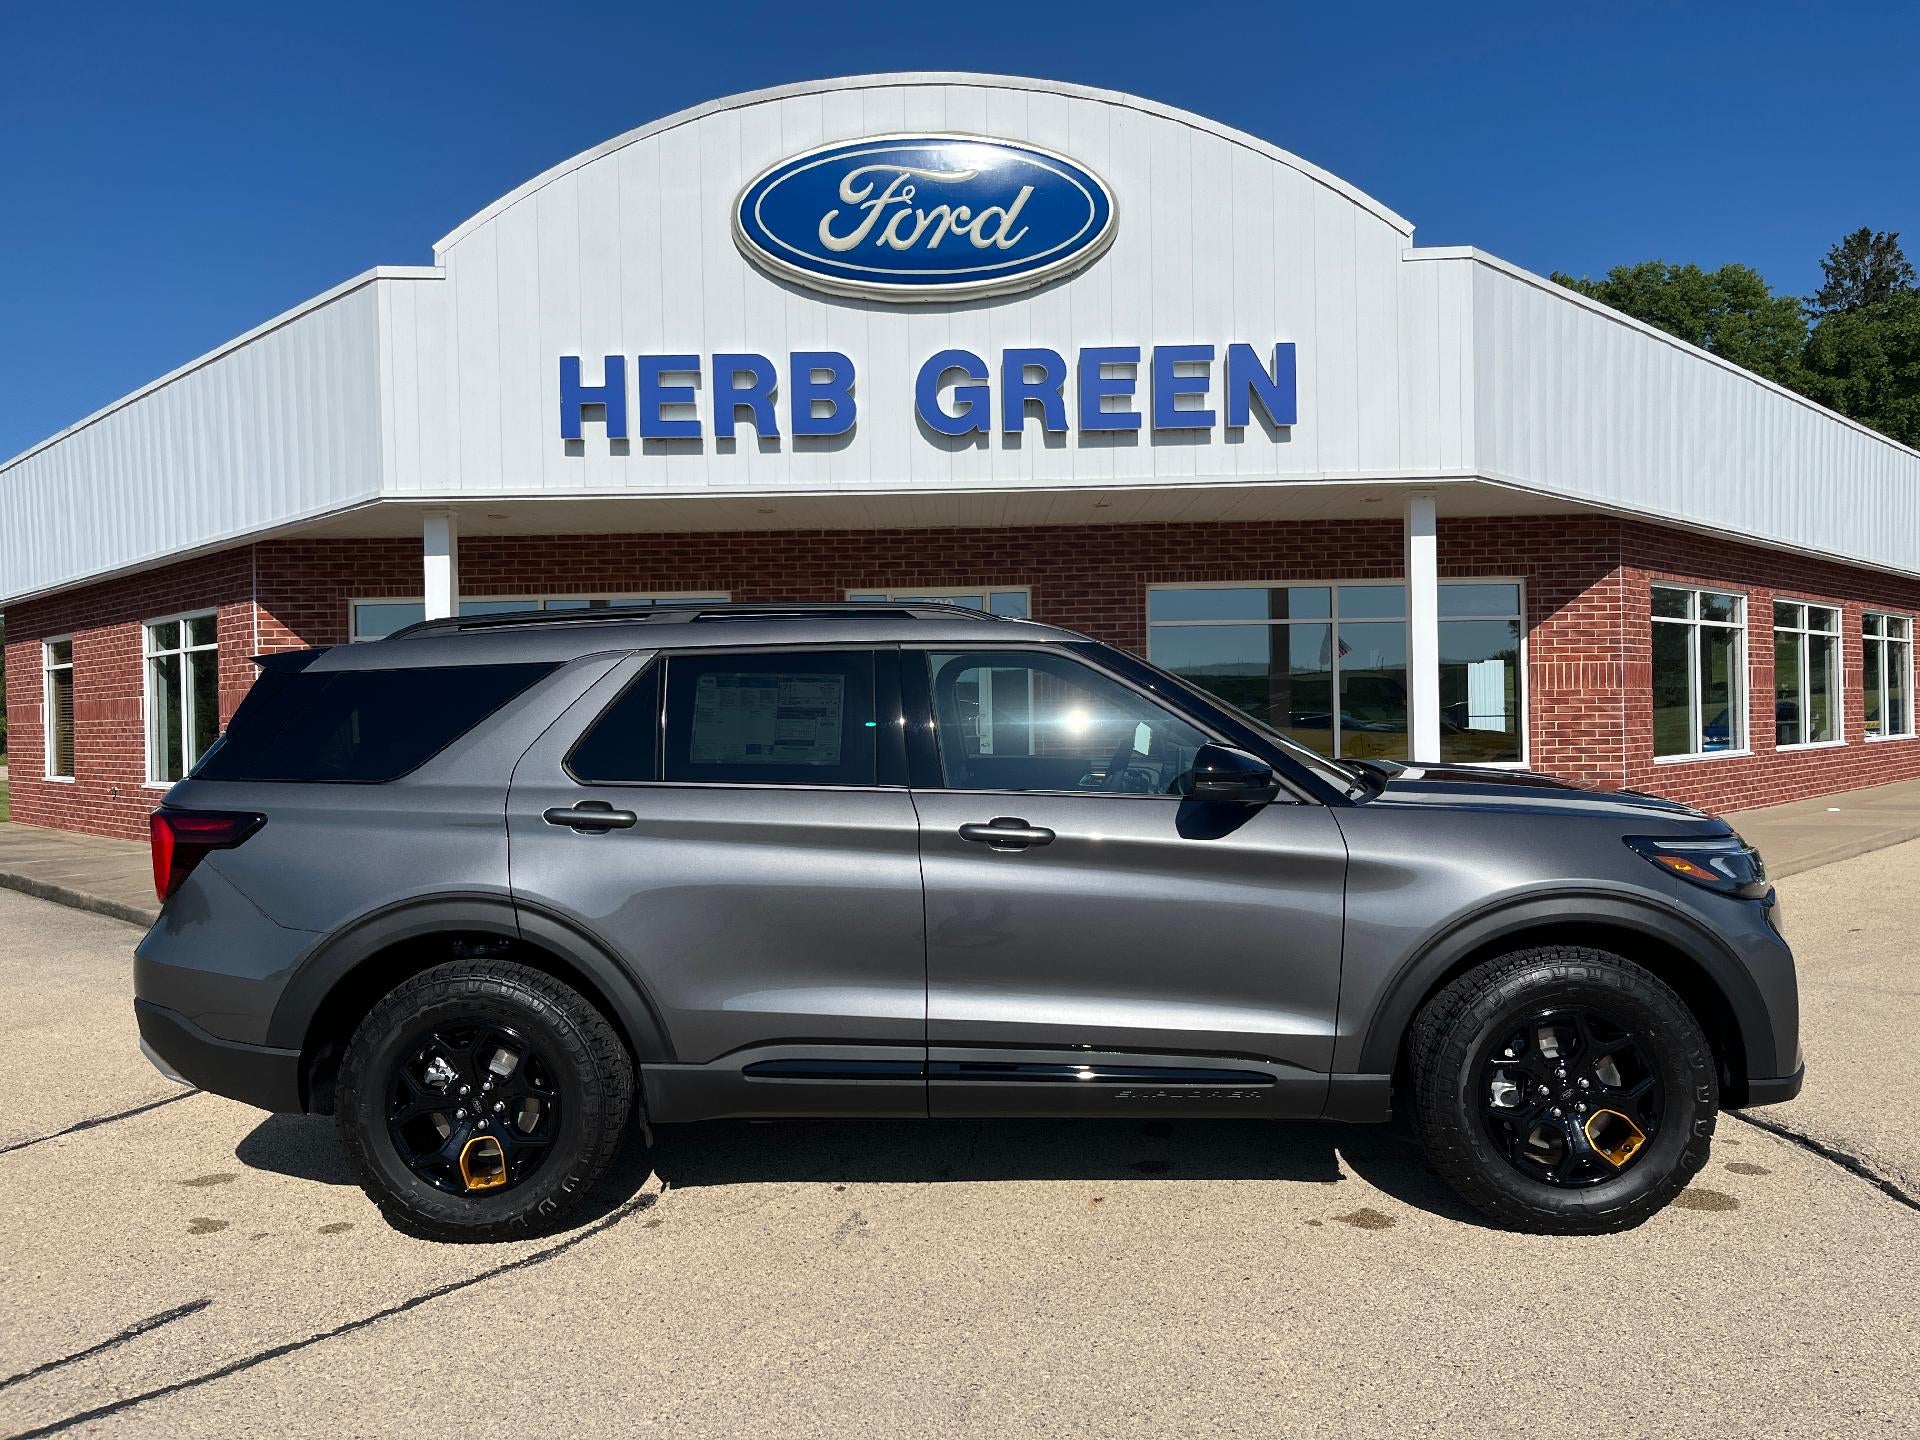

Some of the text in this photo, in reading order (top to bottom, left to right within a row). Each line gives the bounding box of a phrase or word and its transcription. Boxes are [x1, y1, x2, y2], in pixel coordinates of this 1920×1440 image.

[818, 165, 1034, 251] Ford
[560, 343, 1297, 440] HERB GREEN
